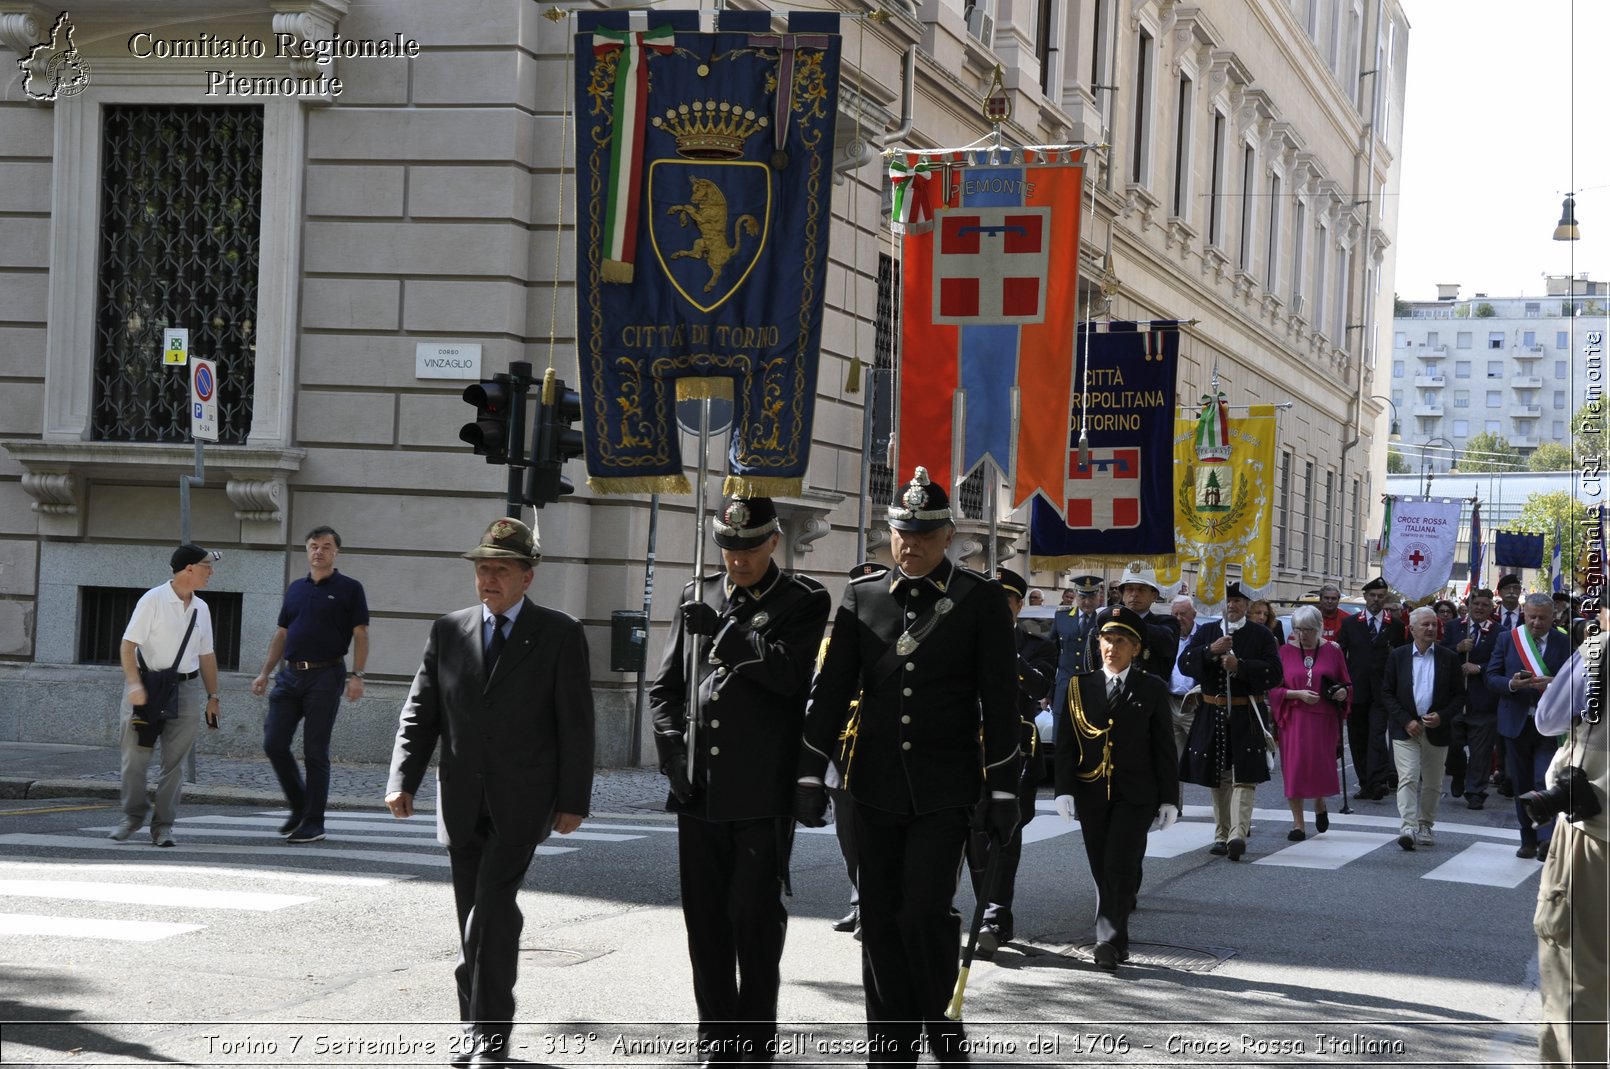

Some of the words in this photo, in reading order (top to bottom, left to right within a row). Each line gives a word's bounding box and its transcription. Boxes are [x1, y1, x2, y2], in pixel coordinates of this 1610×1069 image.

[951, 178, 1036, 199] PIEMONTE
[691, 324, 708, 345] DI
[716, 325, 780, 348] TORINO
[173, 353, 180, 362] 1
[424, 358, 473, 369] VINZAGLIO
[1083, 365, 1124, 386] CITTÀ
[1086, 414, 1140, 431] TORINO
[1397, 516, 1420, 524] CROCE
[1422, 517, 1447, 525] ROSSA
[1404, 525, 1436, 533] ITALIANA
